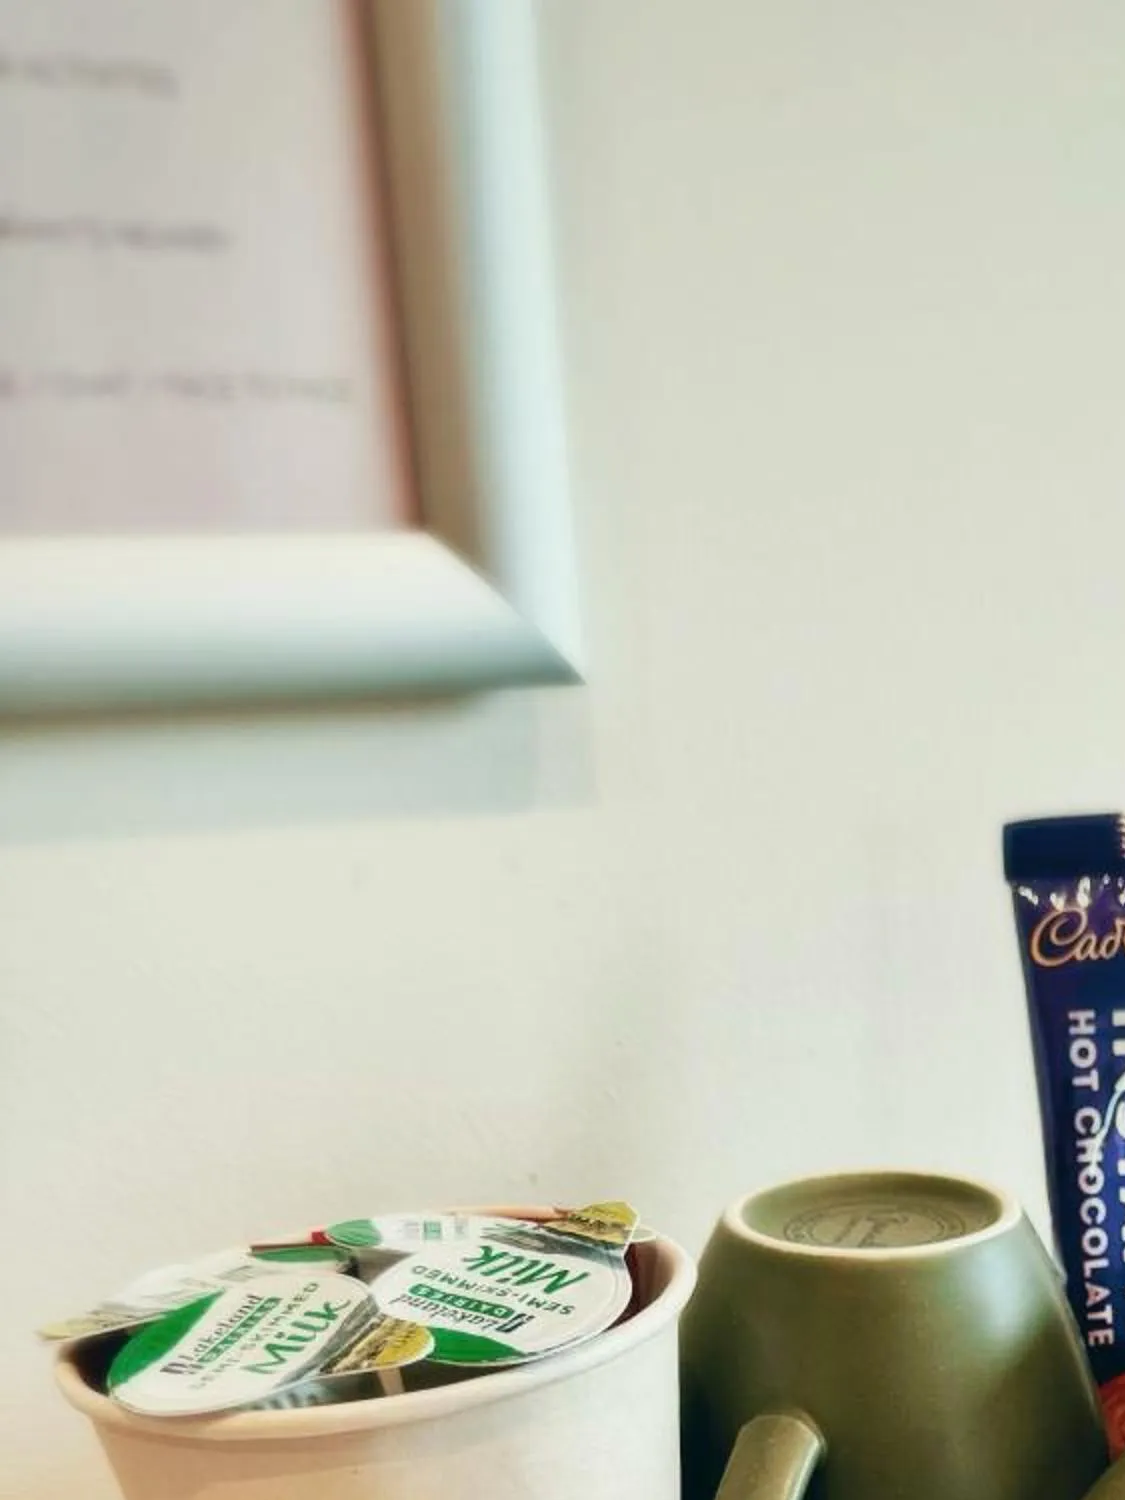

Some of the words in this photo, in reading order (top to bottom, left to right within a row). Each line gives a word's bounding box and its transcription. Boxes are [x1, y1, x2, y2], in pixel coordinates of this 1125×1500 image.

[1067, 1010, 1100, 1092] HOT
[1074, 1106, 1115, 1348] CHOCOLATE
[411, 1264, 576, 1316] SEMI-SKIMMED
[461, 1244, 591, 1295] Milk
[241, 1299, 352, 1375] Milk
